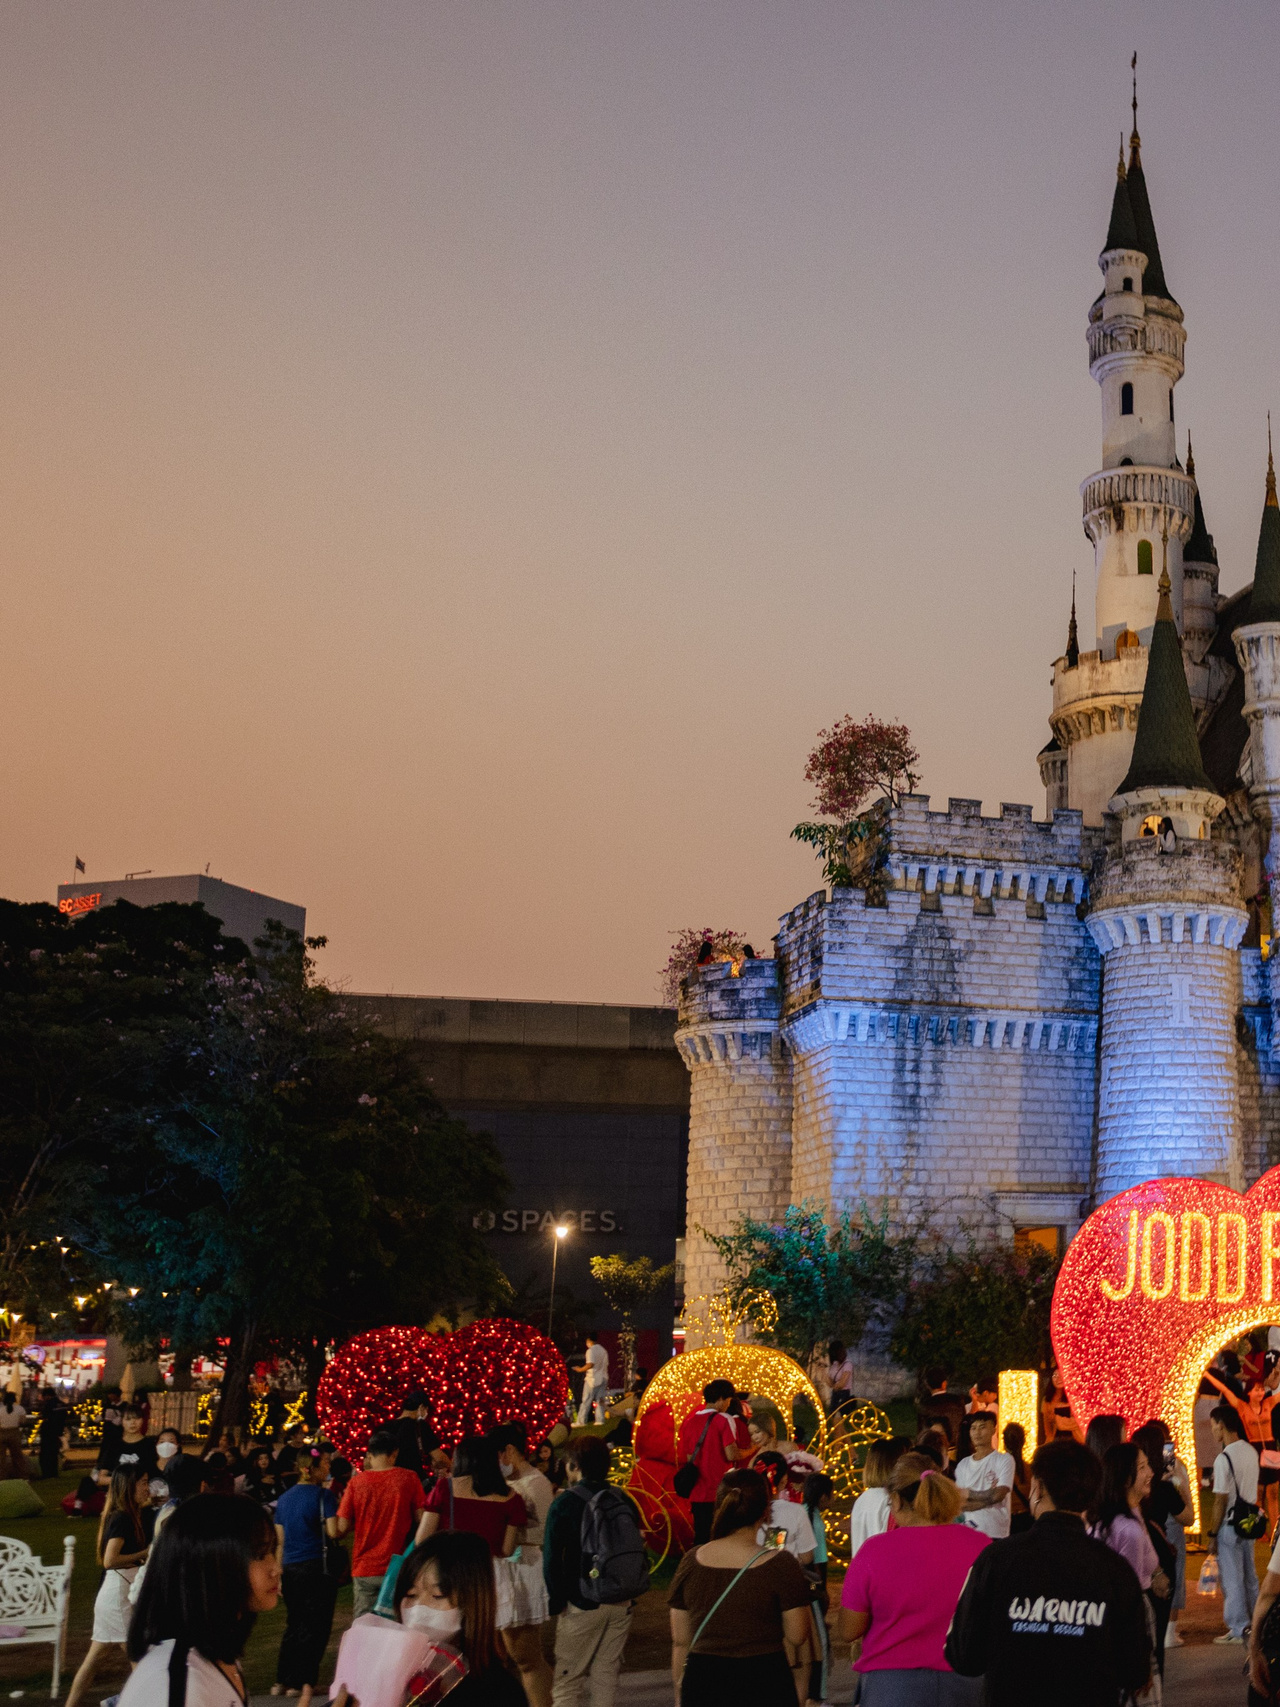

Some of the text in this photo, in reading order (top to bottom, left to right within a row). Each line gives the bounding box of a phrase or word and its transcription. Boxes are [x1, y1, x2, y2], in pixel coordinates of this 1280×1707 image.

[59, 893, 102, 913] SC ASSET
[1101, 1209, 1247, 1303] JODD
[1007, 1594, 1106, 1627] WARNIN
